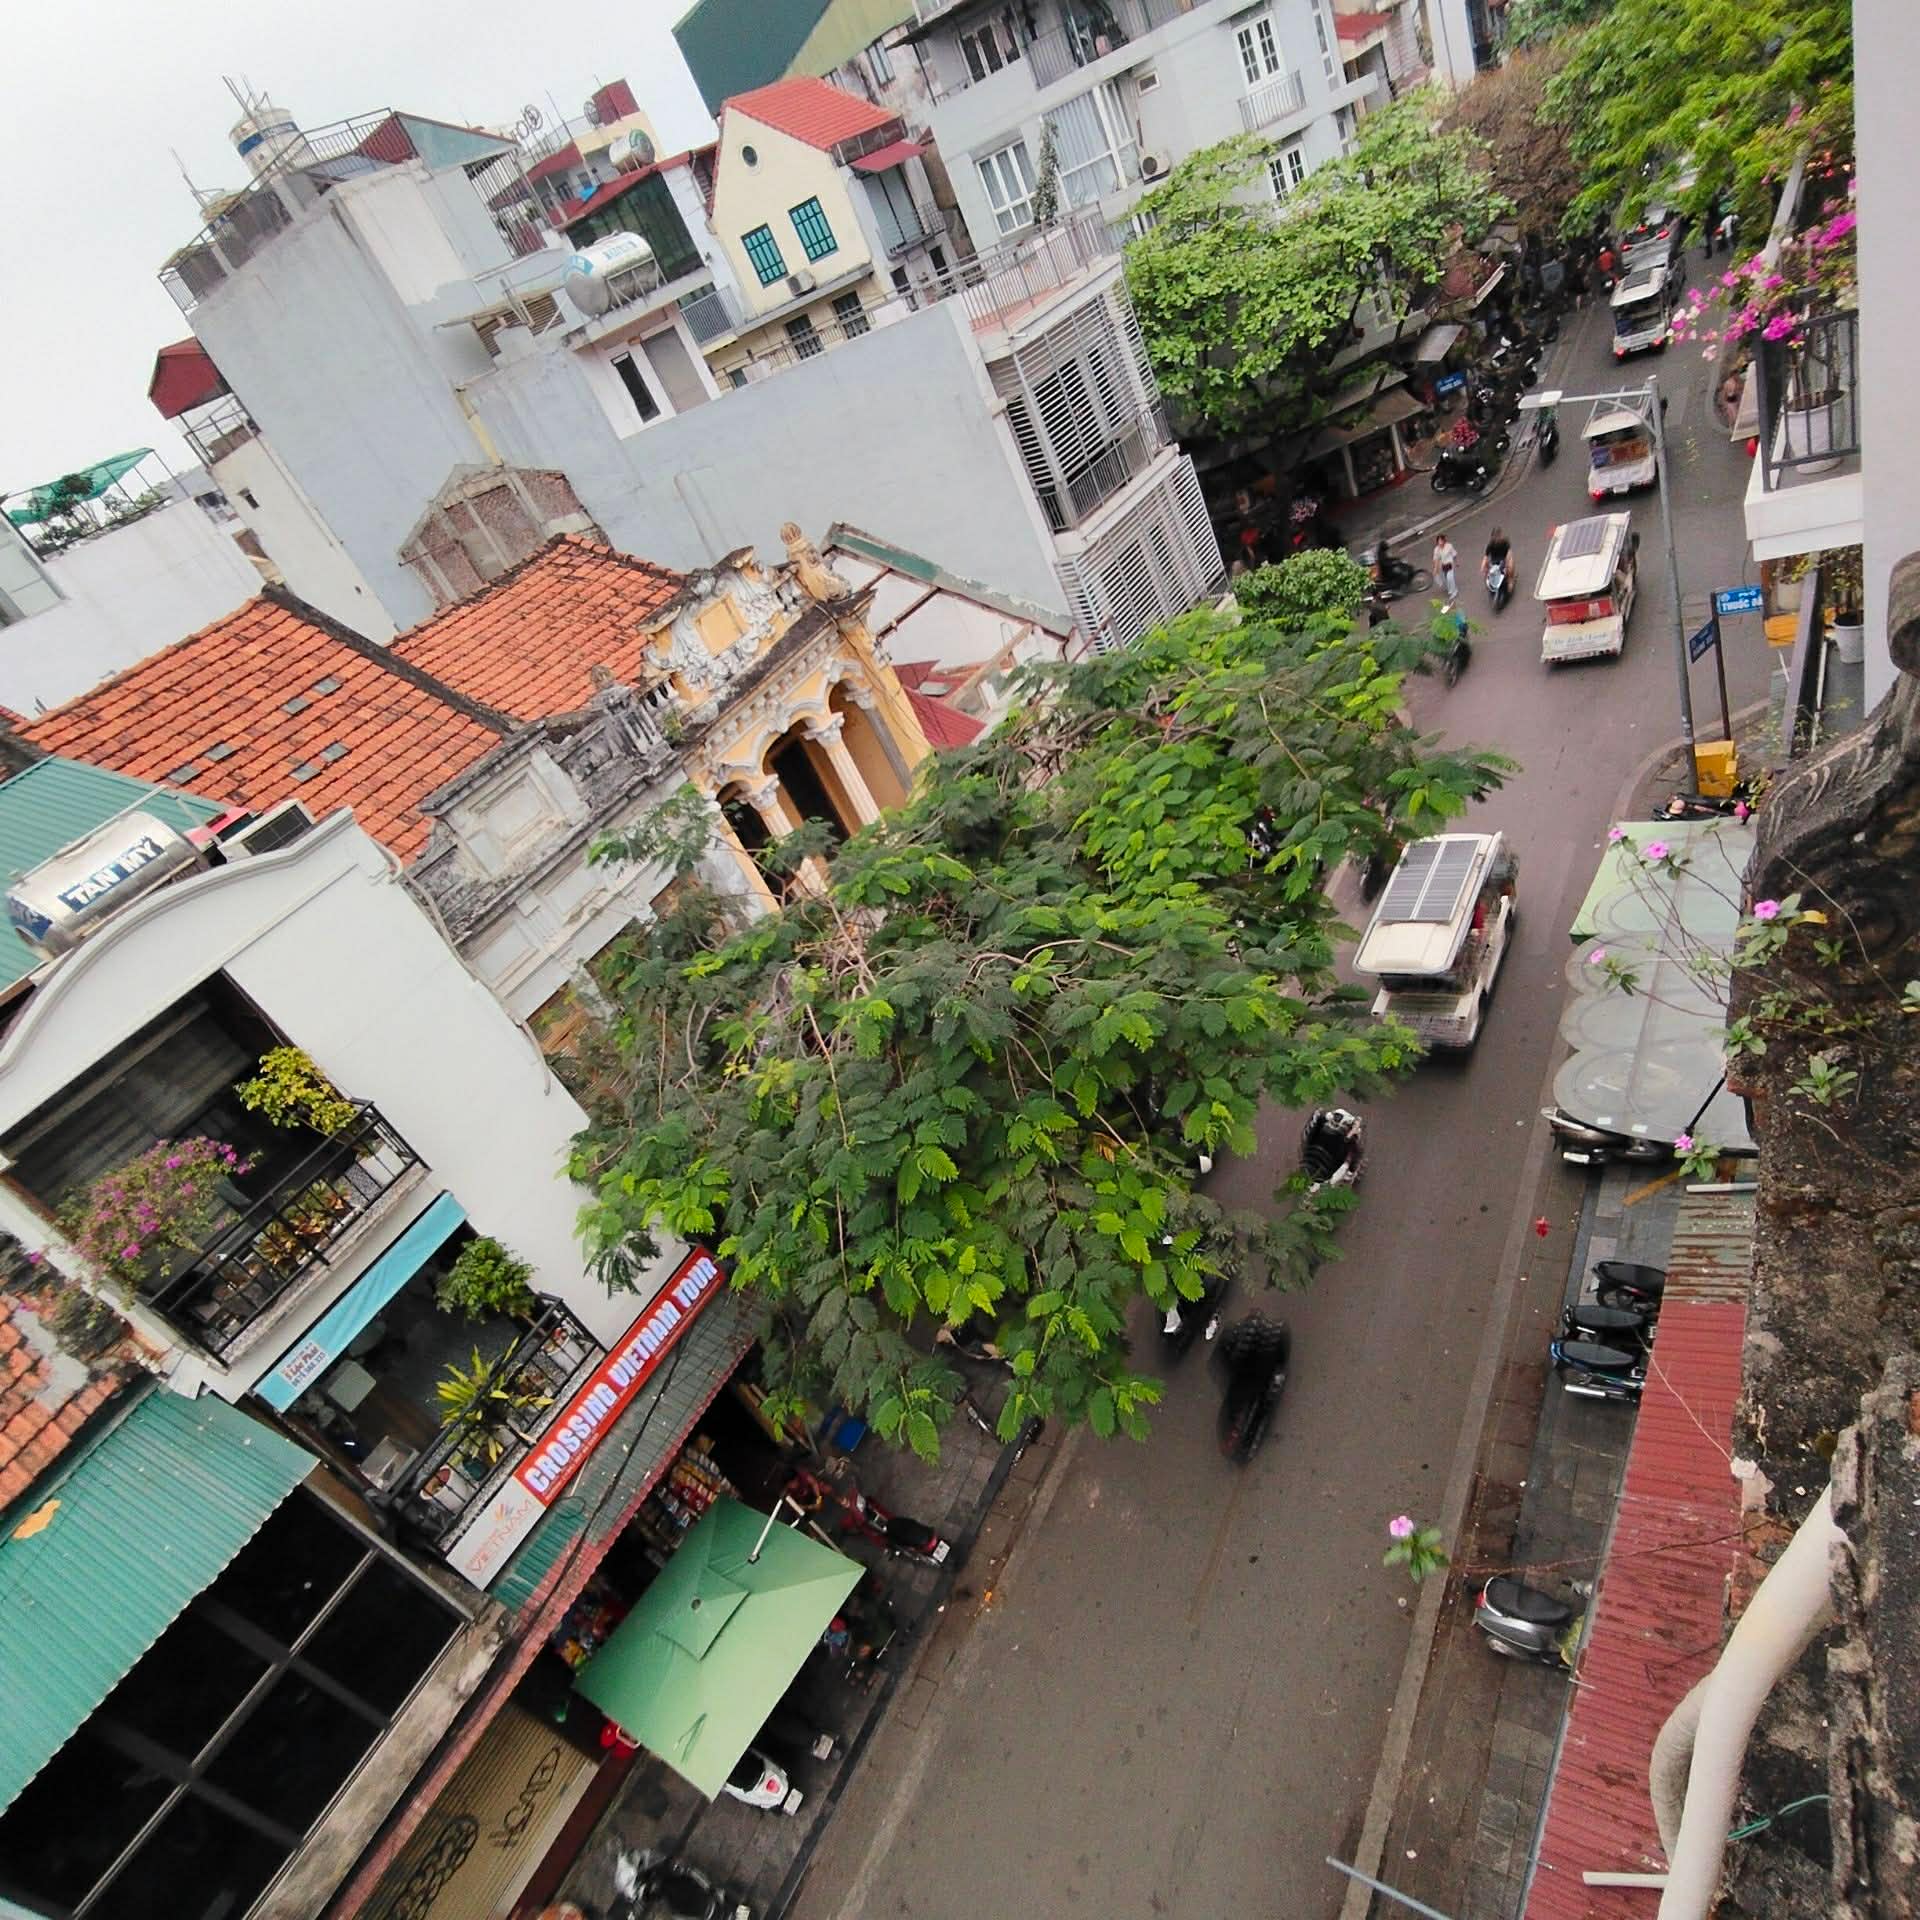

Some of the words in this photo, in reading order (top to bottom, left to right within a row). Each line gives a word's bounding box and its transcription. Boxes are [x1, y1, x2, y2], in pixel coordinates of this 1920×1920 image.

[524, 1382, 618, 1493] CROSSING
[607, 1299, 682, 1388] VIETNAM
[672, 1256, 719, 1308] TOUR
